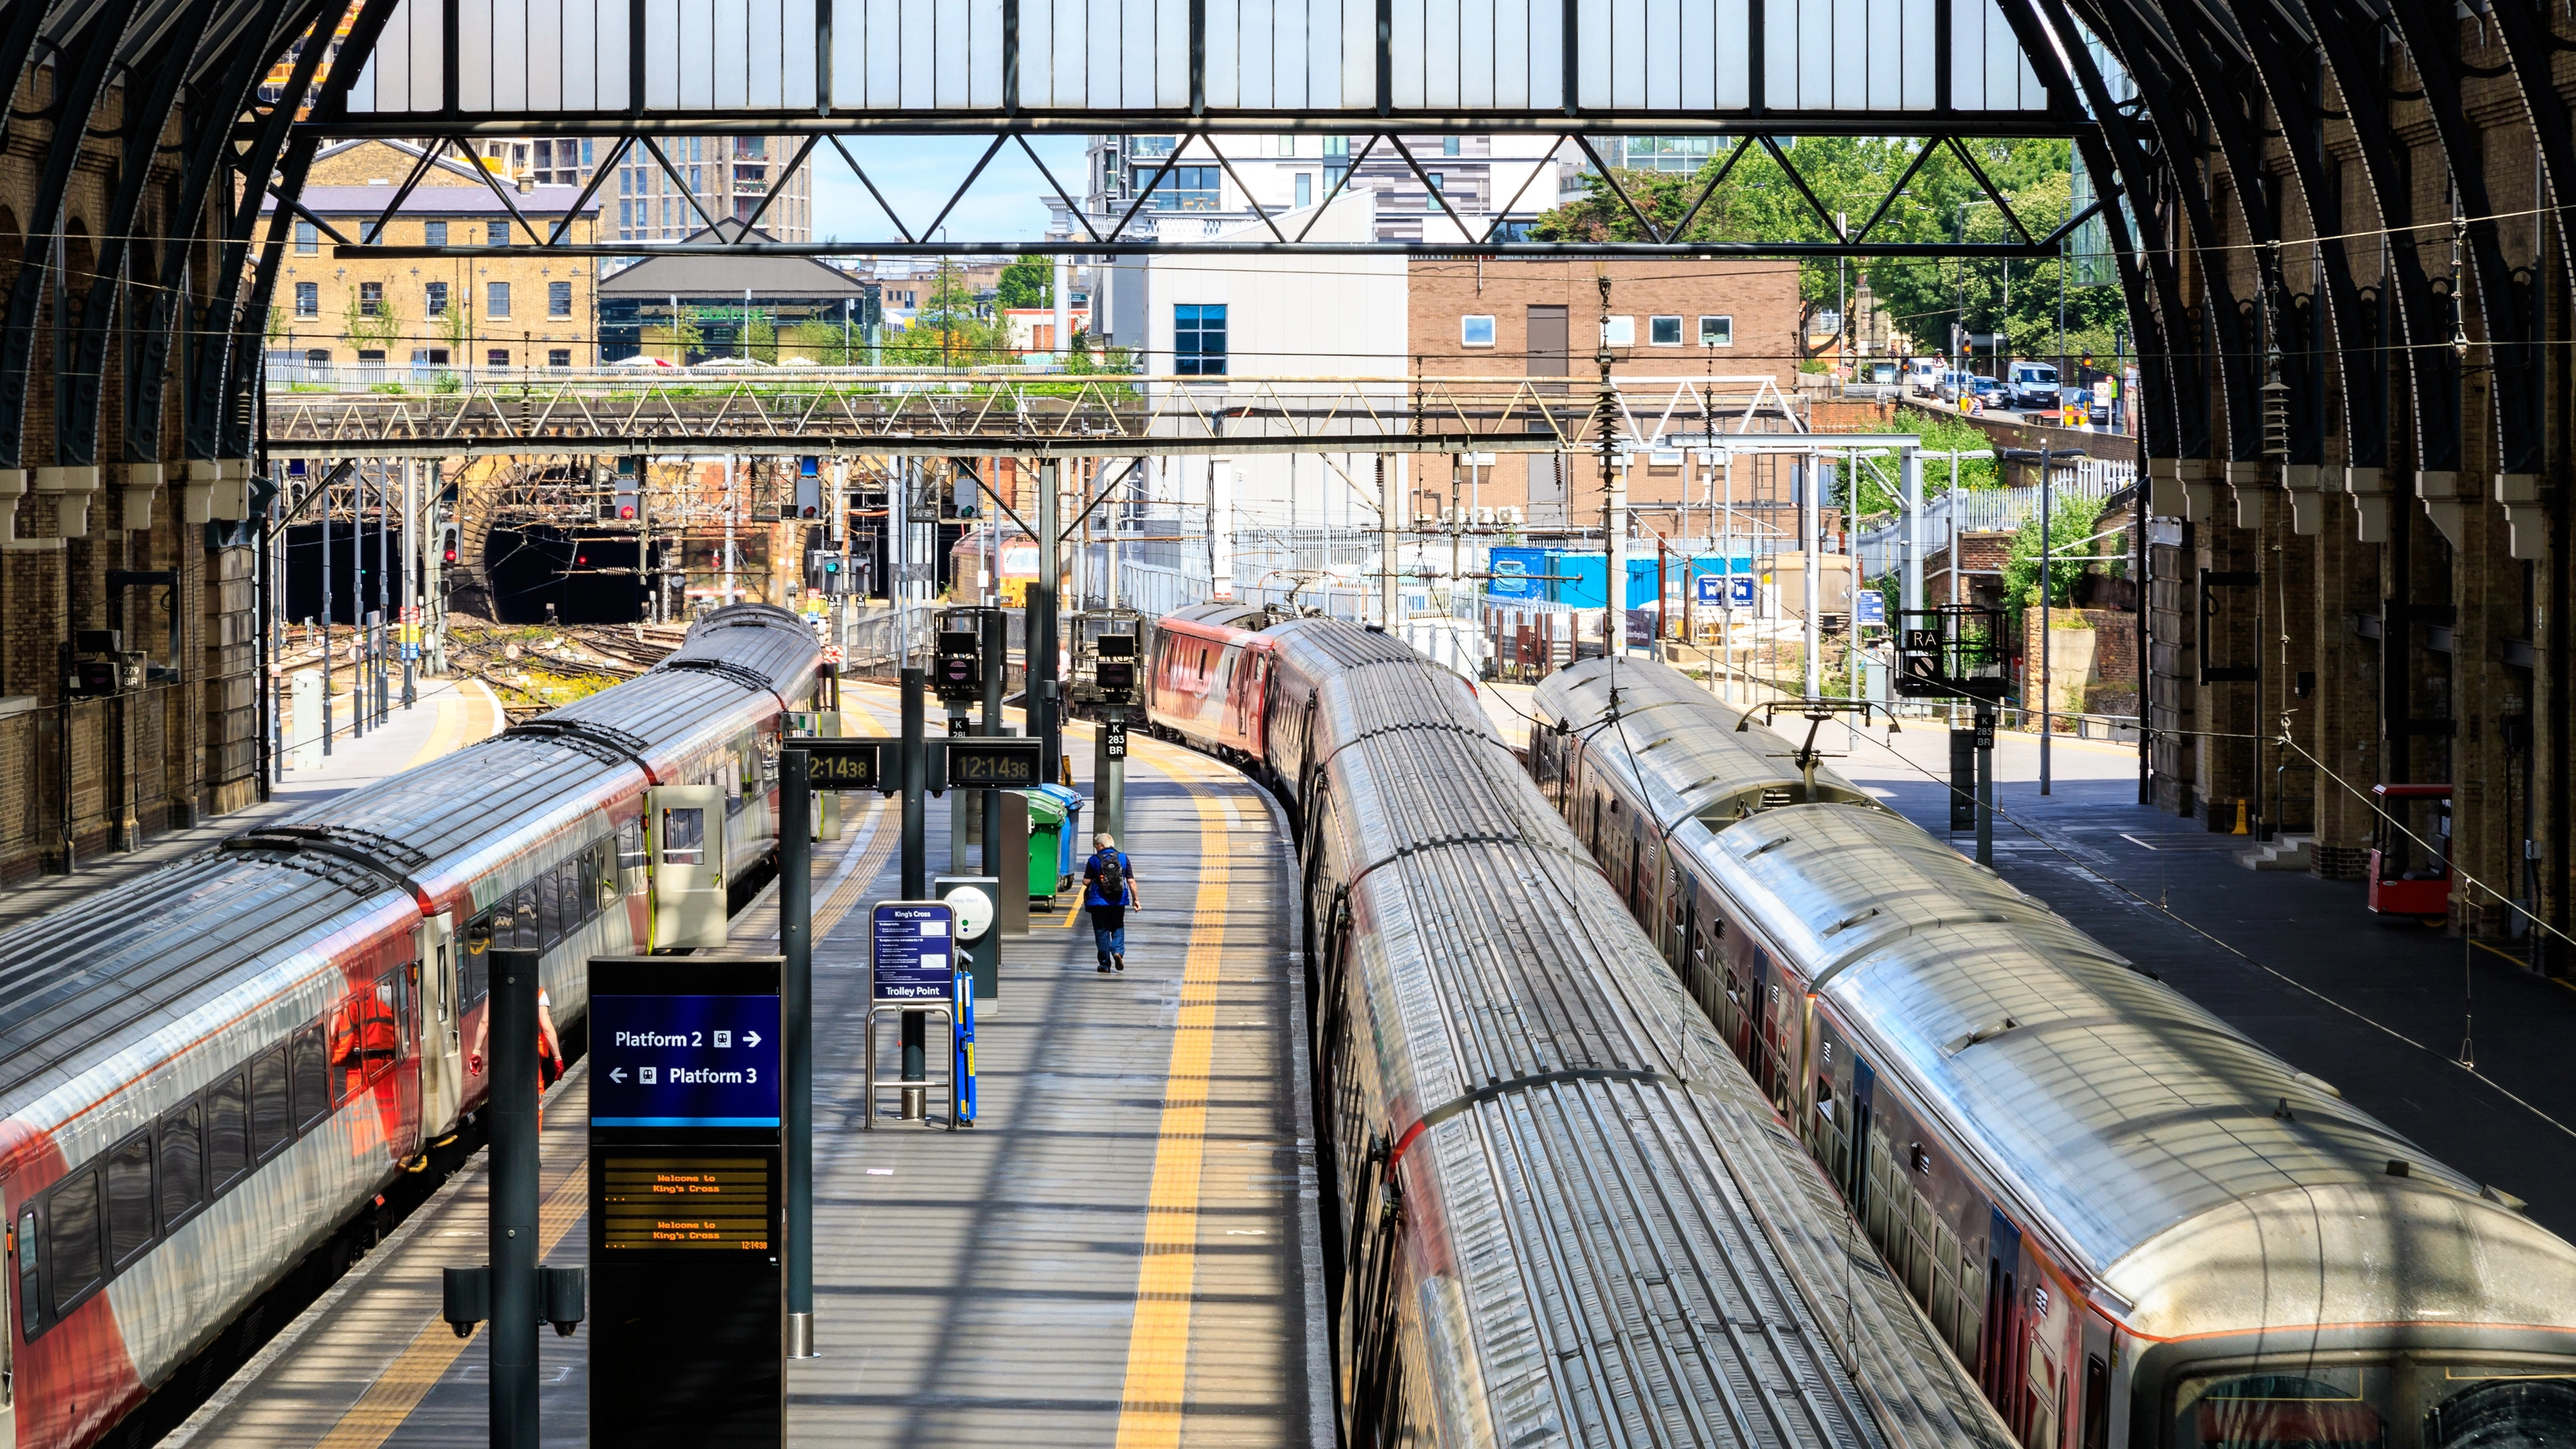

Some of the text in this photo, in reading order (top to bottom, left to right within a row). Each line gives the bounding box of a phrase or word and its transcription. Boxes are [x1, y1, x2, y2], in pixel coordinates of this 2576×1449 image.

[692, 305, 765, 321] Waitrose
[826, 541, 839, 549] RA
[1914, 632, 1936, 647] RA
[128, 656, 135, 664] K
[123, 666, 140, 675] 279
[124, 677, 138, 686] BR
[955, 720, 962, 729] K
[1982, 717, 1988, 725] K
[1112, 724, 1120, 733] K
[1977, 727, 1992, 736] 285
[1108, 736, 1125, 744] 283
[1978, 738, 1990, 746] BR
[1109, 746, 1124, 755] BR
[810, 756, 849, 778] 2:14
[885, 986, 940, 997] Trolley Point
[615, 1031, 702, 1047] Platform 2
[670, 1067, 757, 1083] Platform 3
[653, 1185, 720, 1193] King's Cross
[653, 1232, 684, 1240] King's
[741, 1241, 767, 1250] 12:14:38
